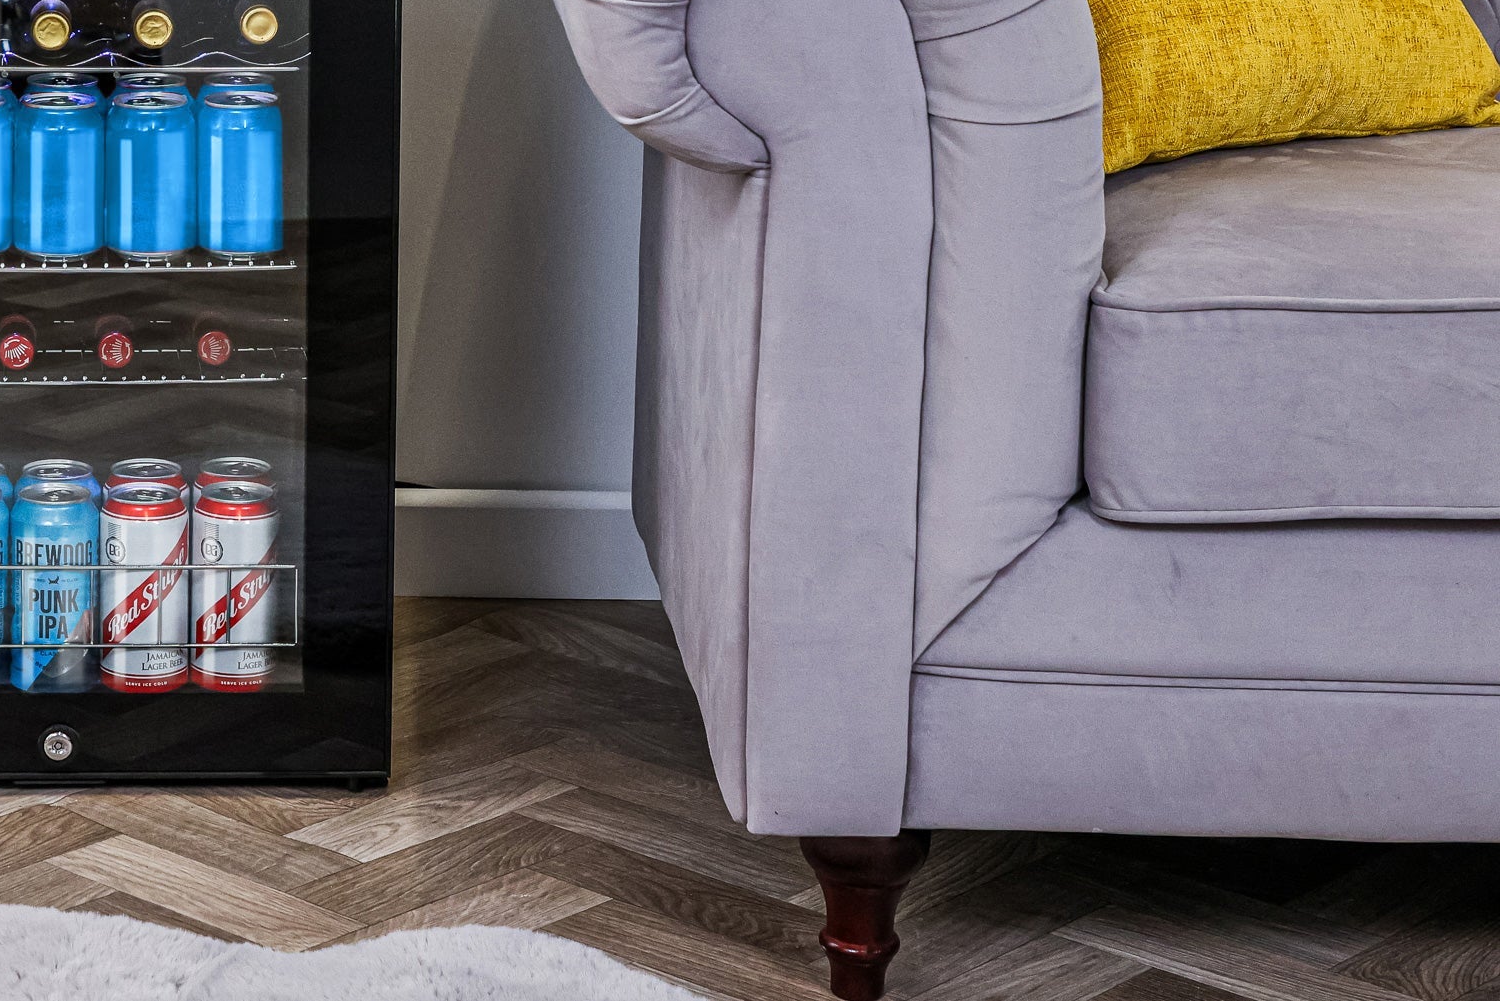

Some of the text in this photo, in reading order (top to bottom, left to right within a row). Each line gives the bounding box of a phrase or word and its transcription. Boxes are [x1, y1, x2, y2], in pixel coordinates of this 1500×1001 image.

[16, 539, 93, 565] BREWDOG
[28, 587, 79, 614] PUNK
[38, 615, 69, 639] IPA
[108, 598, 140, 643] Red
[141, 657, 184, 671] LAGER BEER
[237, 660, 263, 670] LAGER
